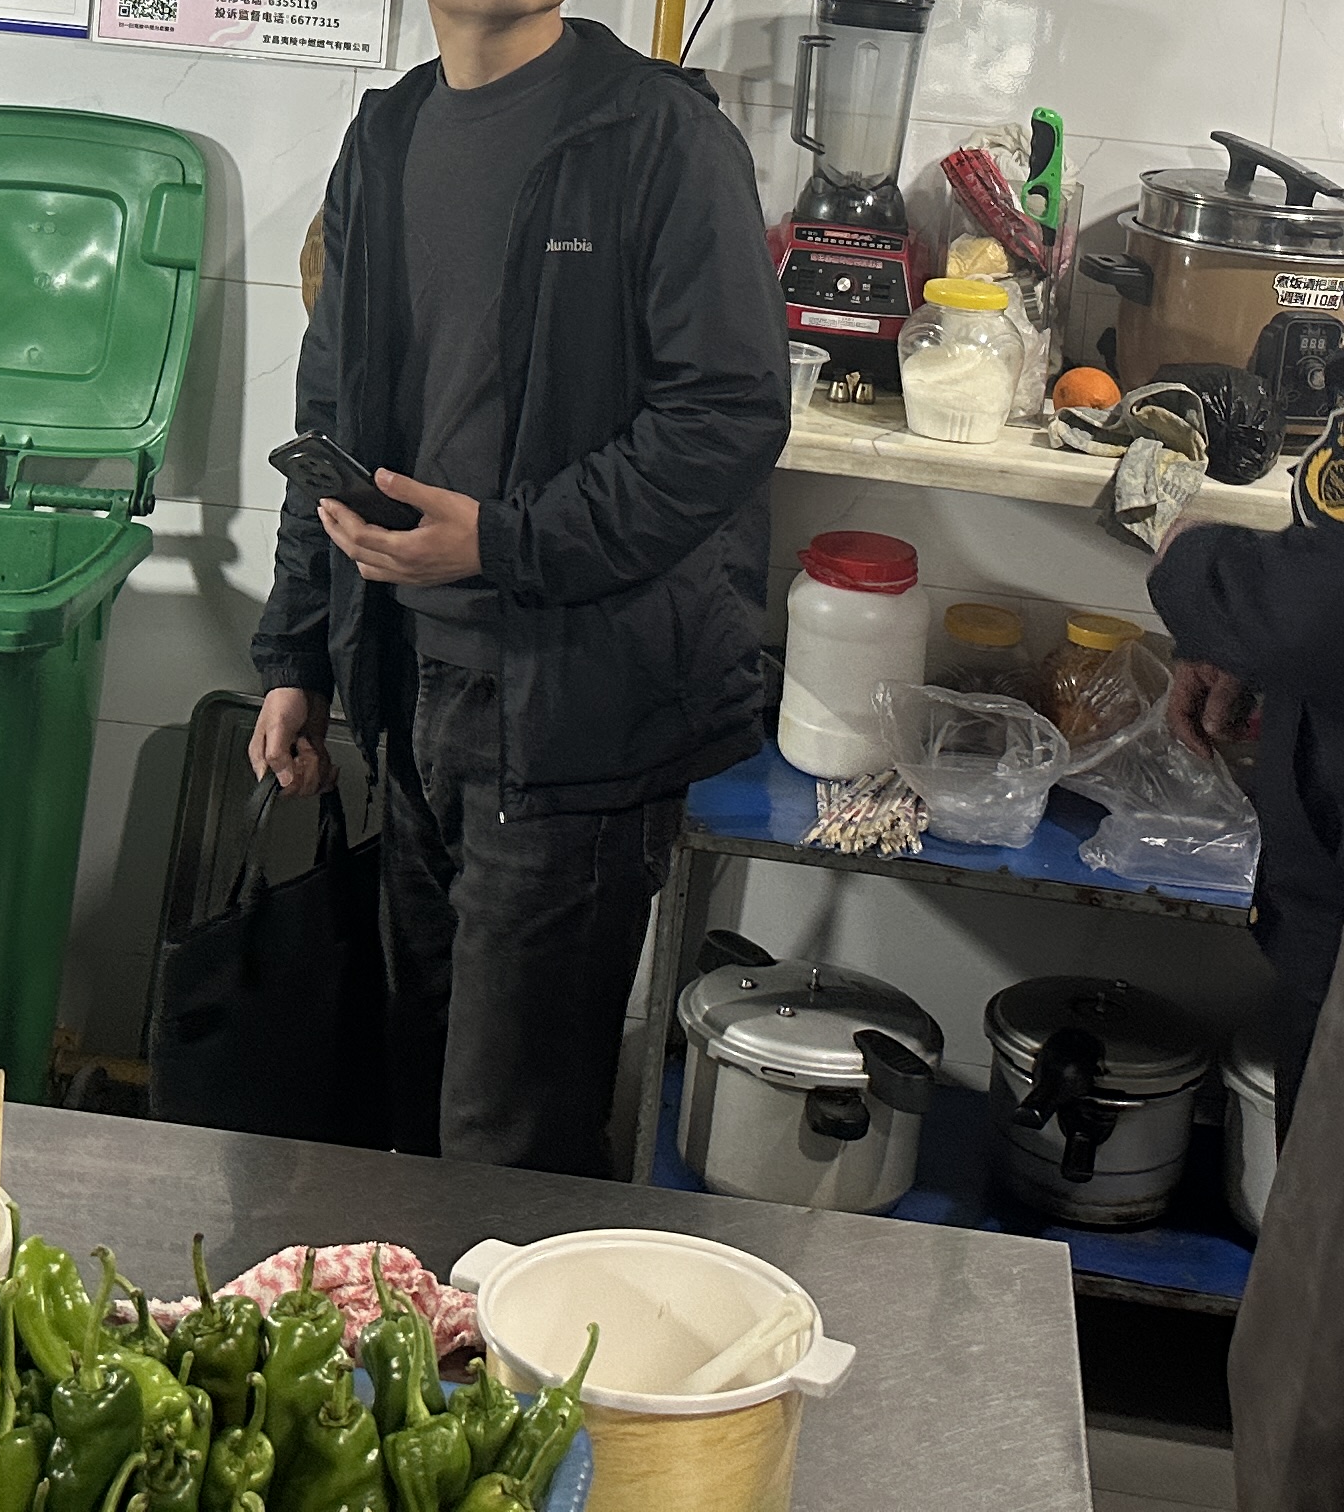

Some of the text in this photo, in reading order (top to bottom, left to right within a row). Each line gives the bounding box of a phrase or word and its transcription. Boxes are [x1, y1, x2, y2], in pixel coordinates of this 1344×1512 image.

[214, 7, 340, 28] 投诉监督电话:6677315
[262, 35, 370, 53] 宜昌夷陵中燃燃气有限公司
